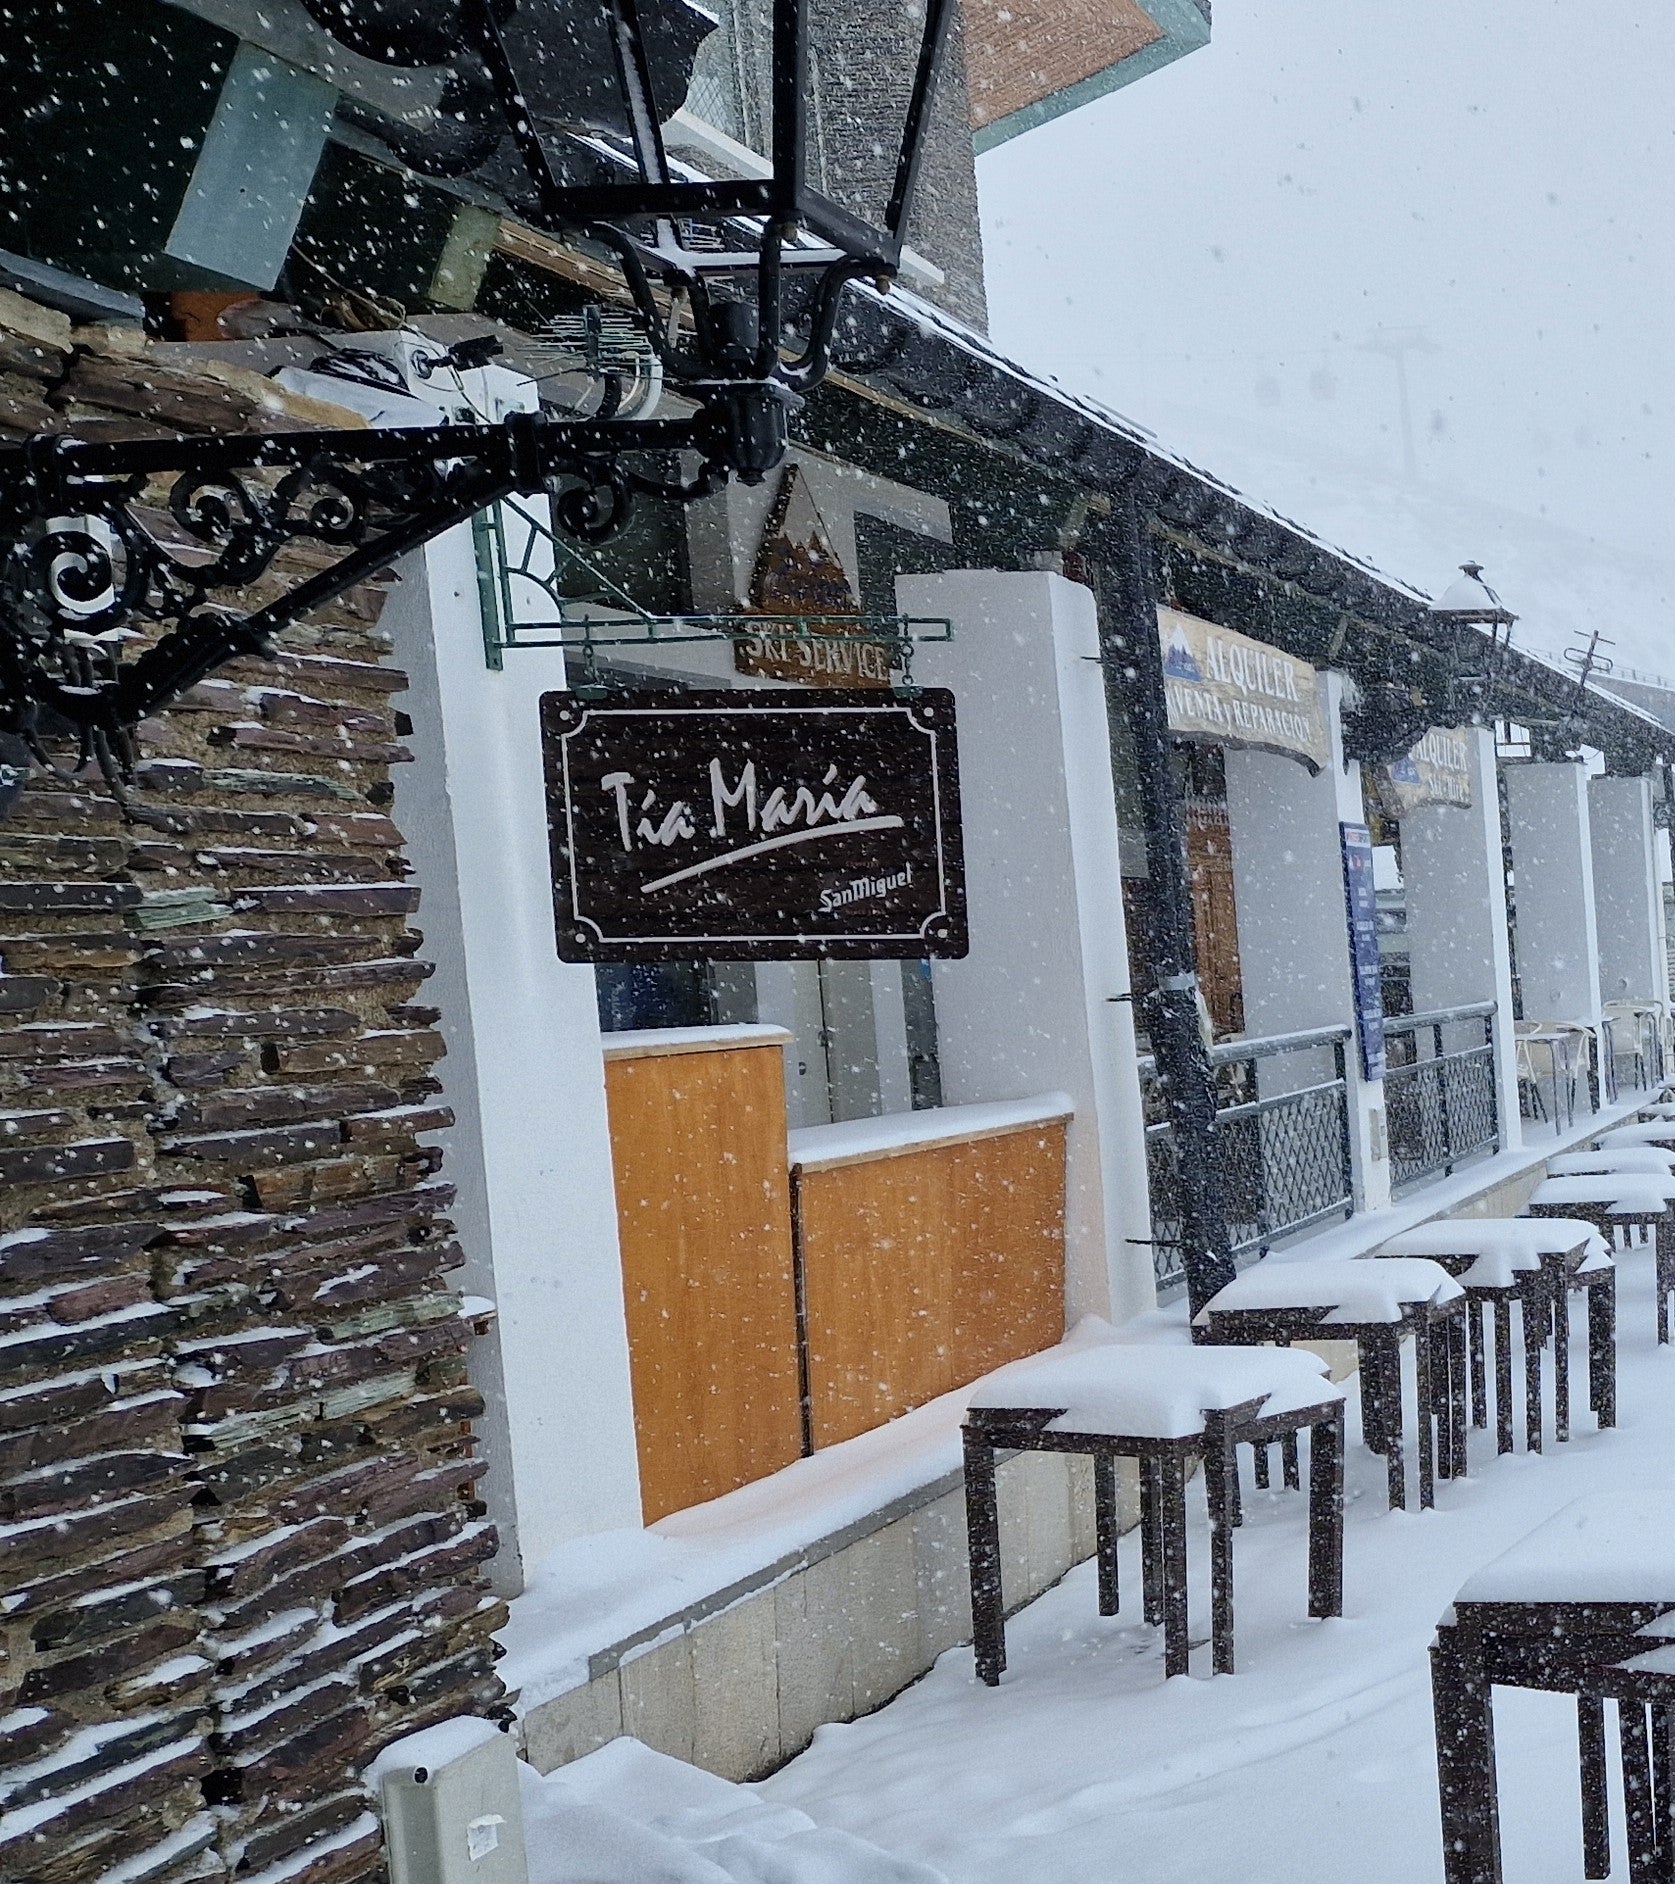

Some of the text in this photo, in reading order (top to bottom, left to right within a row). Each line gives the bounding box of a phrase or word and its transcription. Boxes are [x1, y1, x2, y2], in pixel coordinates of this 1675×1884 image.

[797, 637, 888, 681] SERVICE
[1206, 636, 1298, 701] ALQUILER
[1174, 686, 1223, 724] VENTA
[1413, 732, 1467, 771] ALQUILER
[709, 757, 876, 837] María
